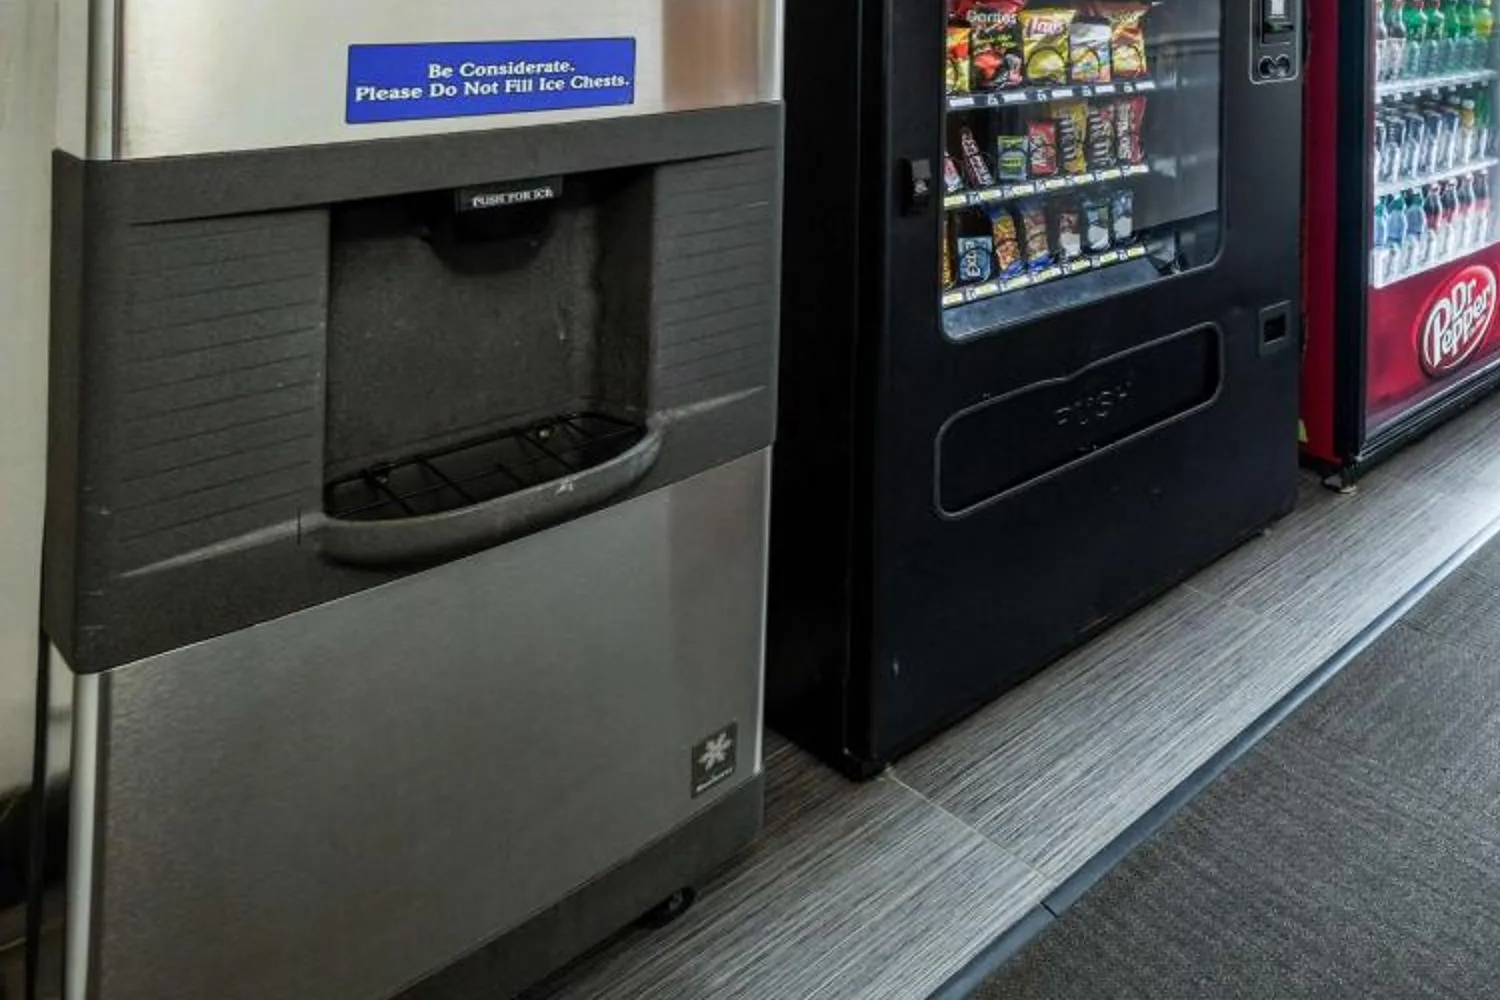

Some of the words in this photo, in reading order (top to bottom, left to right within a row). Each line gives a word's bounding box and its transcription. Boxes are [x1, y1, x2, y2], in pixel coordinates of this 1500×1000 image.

[966, 9, 1017, 25] Doritos
[428, 63, 453, 79] Be
[459, 60, 575, 78] Considerate.
[355, 85, 423, 102] Please
[429, 82, 457, 99] Do
[464, 81, 499, 96] Not
[505, 78, 533, 94] Fill
[539, 76, 565, 92] Ice
[570, 73, 630, 90] Chests.
[472, 192, 504, 208] PUSH
[505, 190, 532, 204] FOR
[533, 186, 554, 200] ICE
[1450, 278, 1478, 321] Dr
[1428, 284, 1492, 369] Pepper
